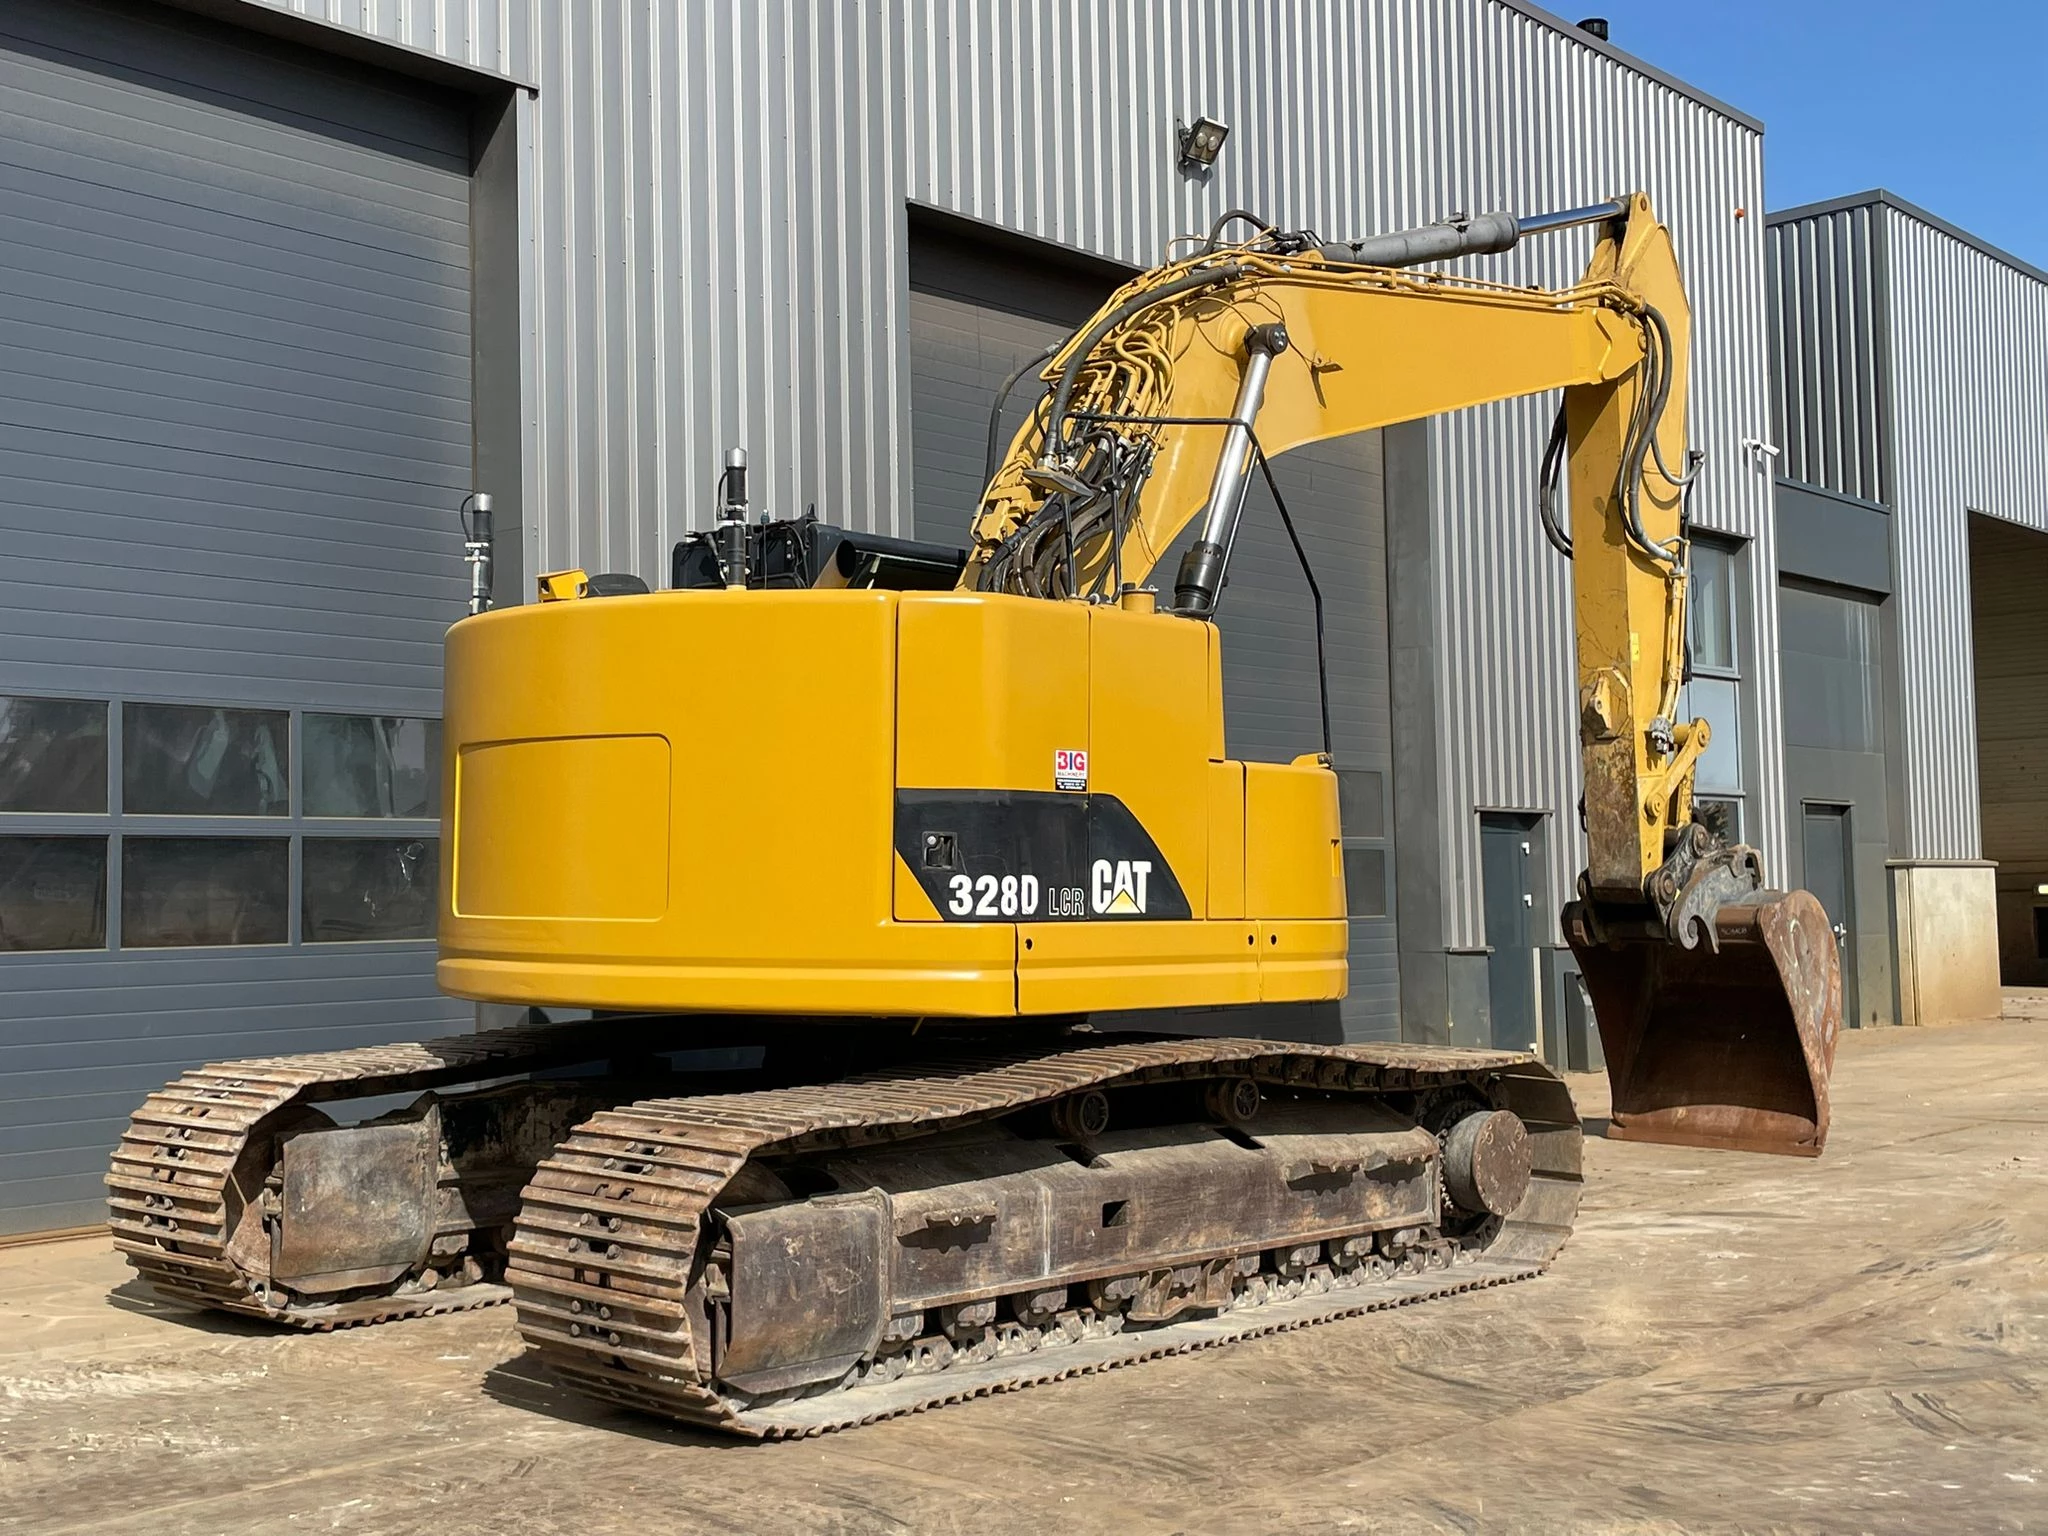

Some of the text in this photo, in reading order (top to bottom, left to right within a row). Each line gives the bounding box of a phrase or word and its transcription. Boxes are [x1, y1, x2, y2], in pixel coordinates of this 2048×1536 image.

[1058, 751, 1085, 771] BIG
[948, 858, 1152, 917] 328D LCR CAT
